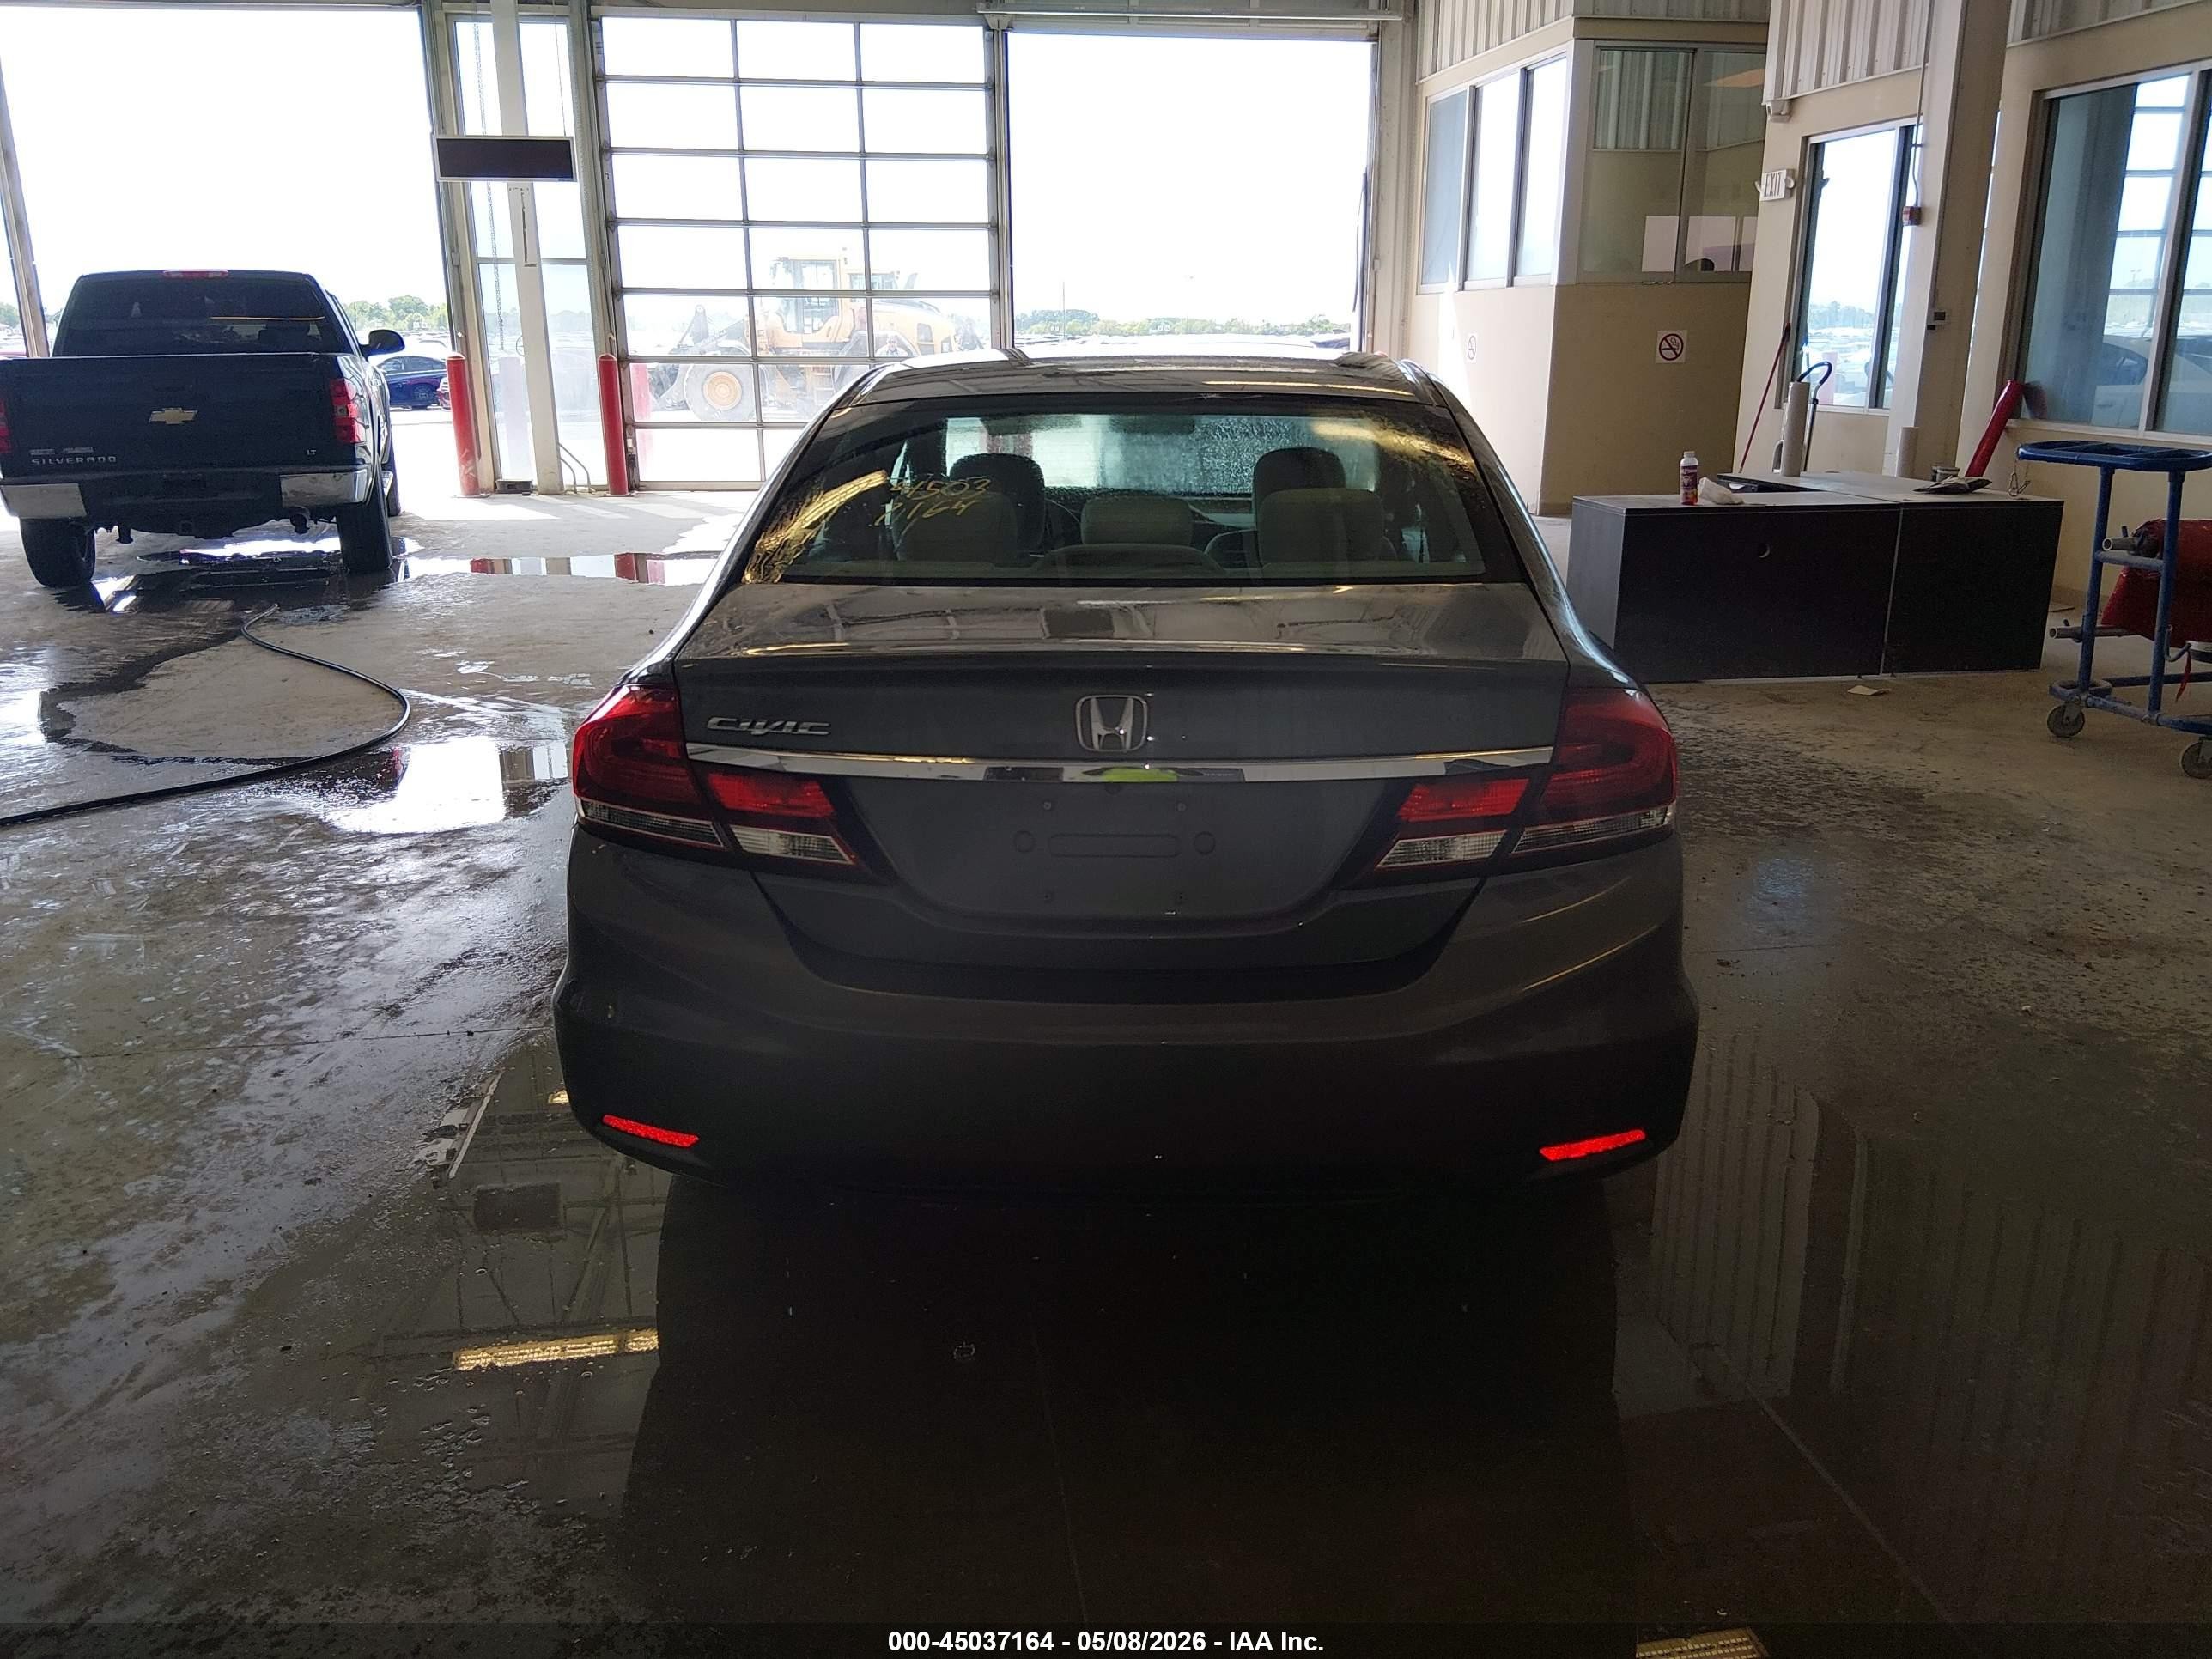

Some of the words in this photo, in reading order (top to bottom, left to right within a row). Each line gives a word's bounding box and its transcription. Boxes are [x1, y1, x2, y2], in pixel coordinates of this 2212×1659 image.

[1764, 172, 1782, 197] EXIT
[31, 455, 118, 465] SILVERADO
[707, 716, 831, 736] CIVIC
